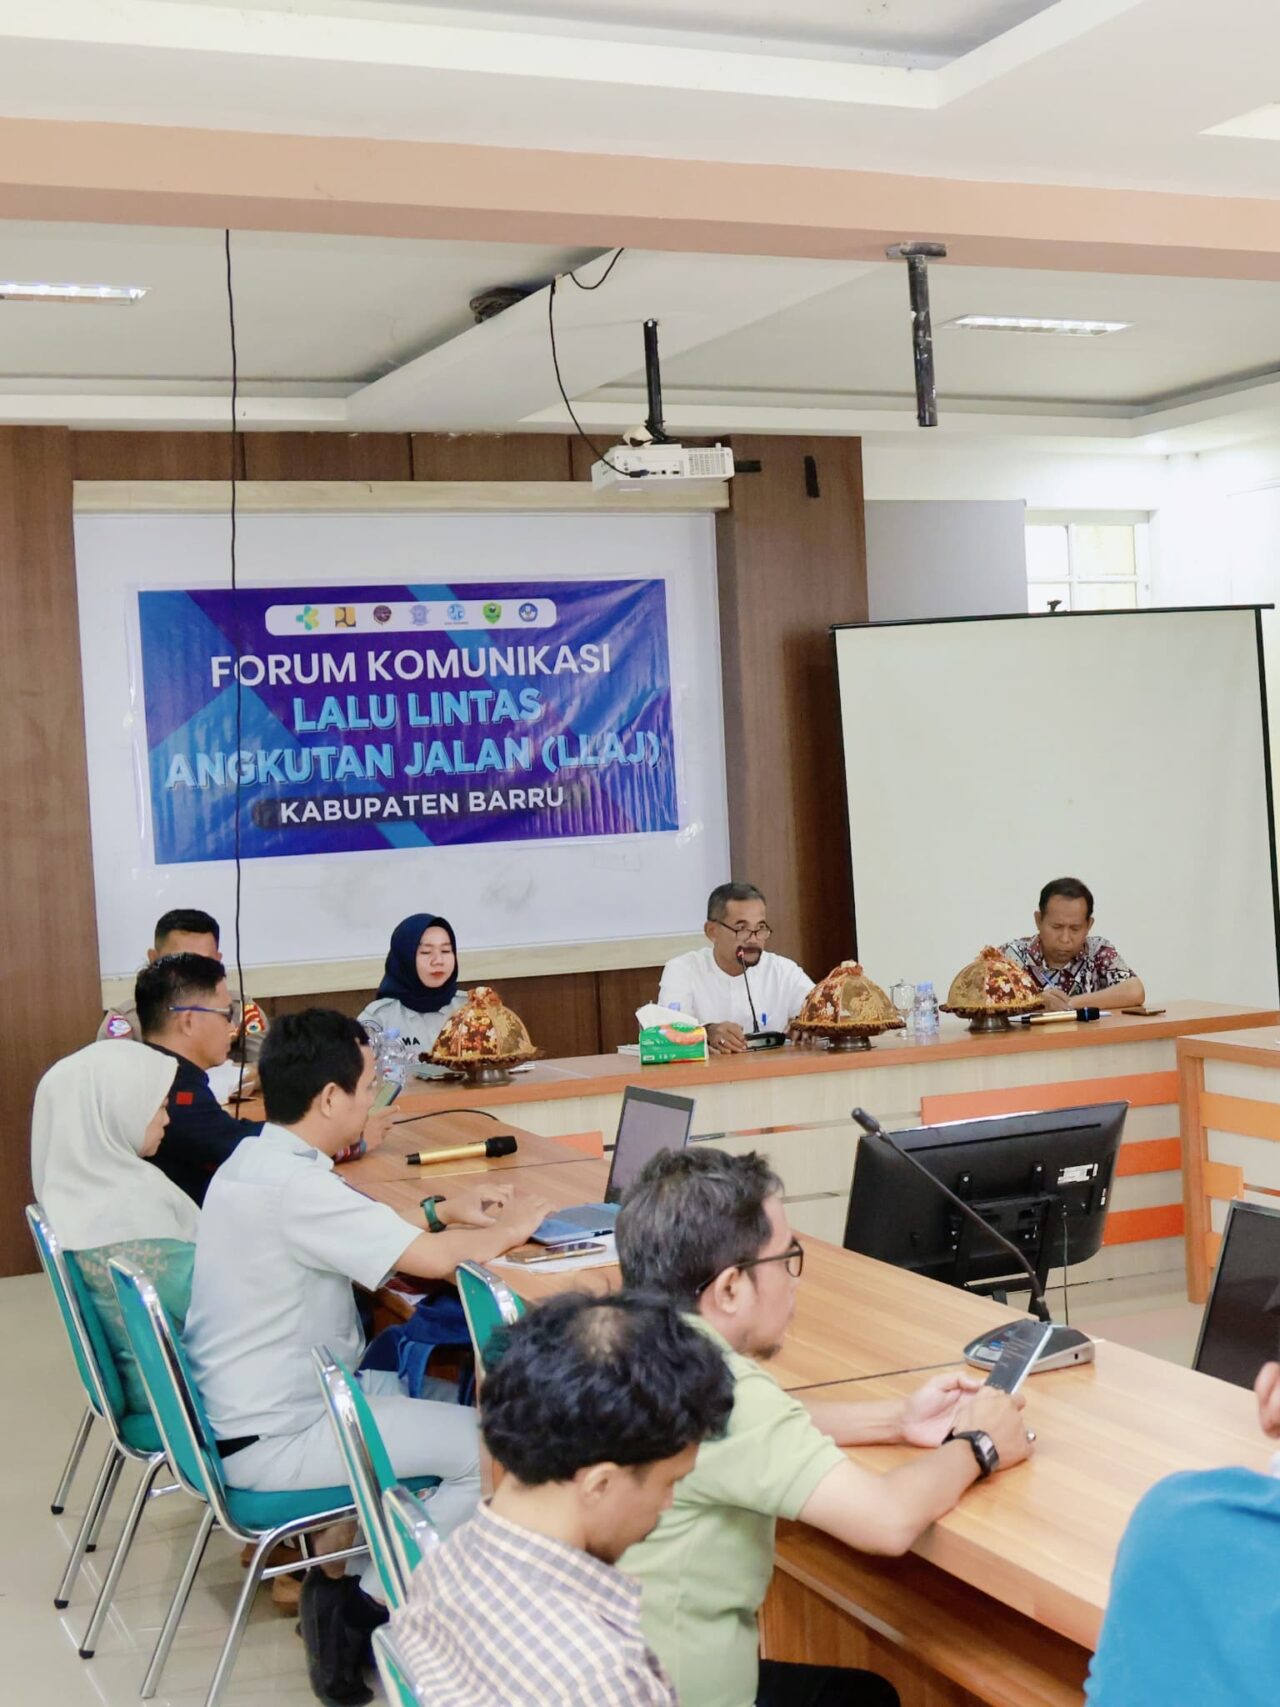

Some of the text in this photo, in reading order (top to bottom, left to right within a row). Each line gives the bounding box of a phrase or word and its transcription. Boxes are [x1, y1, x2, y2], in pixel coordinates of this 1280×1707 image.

[211, 643, 611, 687] FORUM KOMUNIKASI
[293, 687, 543, 733] LALU LINTAS
[165, 730, 661, 789] ANGKUTAN JALAN (LLAJ)
[280, 787, 564, 824] KABUPATEN BARRU
